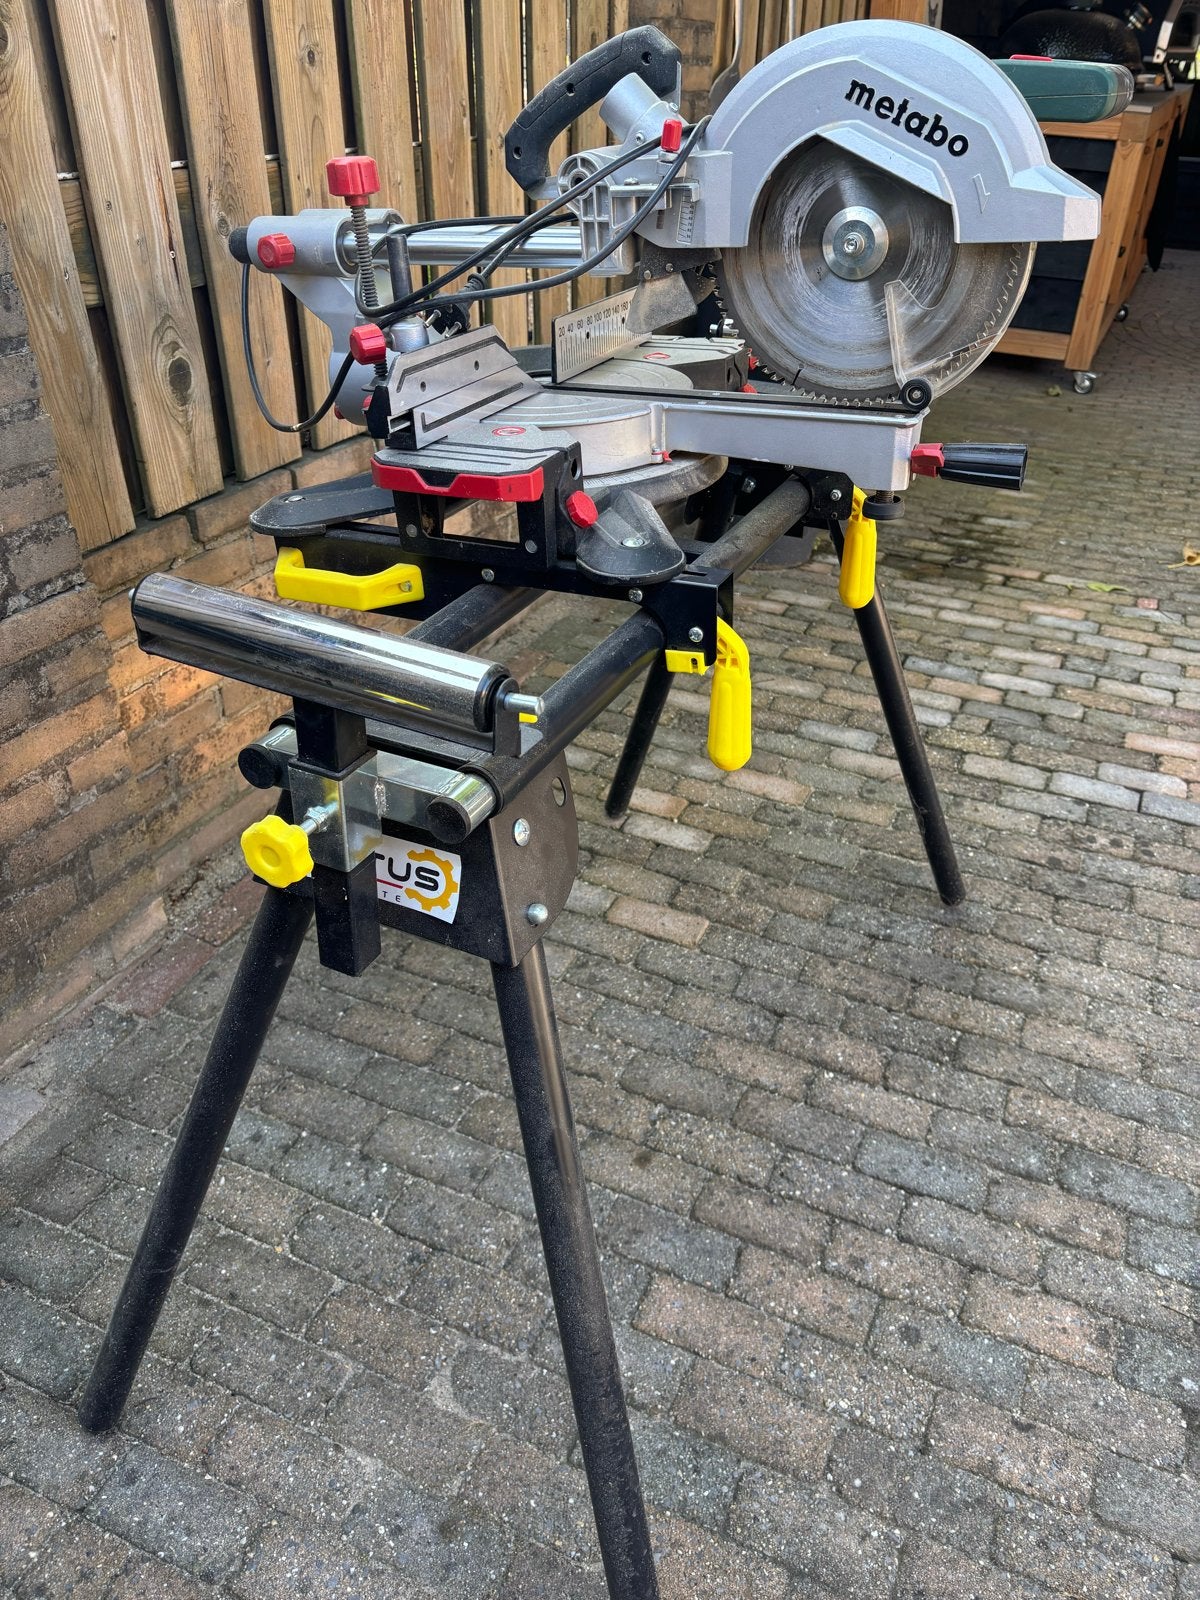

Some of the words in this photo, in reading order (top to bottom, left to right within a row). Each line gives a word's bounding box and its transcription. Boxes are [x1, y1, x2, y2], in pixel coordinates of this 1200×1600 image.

[844, 79, 969, 157] metabo
[558, 326, 566, 338] 20
[568, 323, 574, 333] 40
[576, 319, 584, 330] 60
[586, 316, 593, 326] 80
[594, 312, 602, 323] 100
[612, 305, 620, 316] 140
